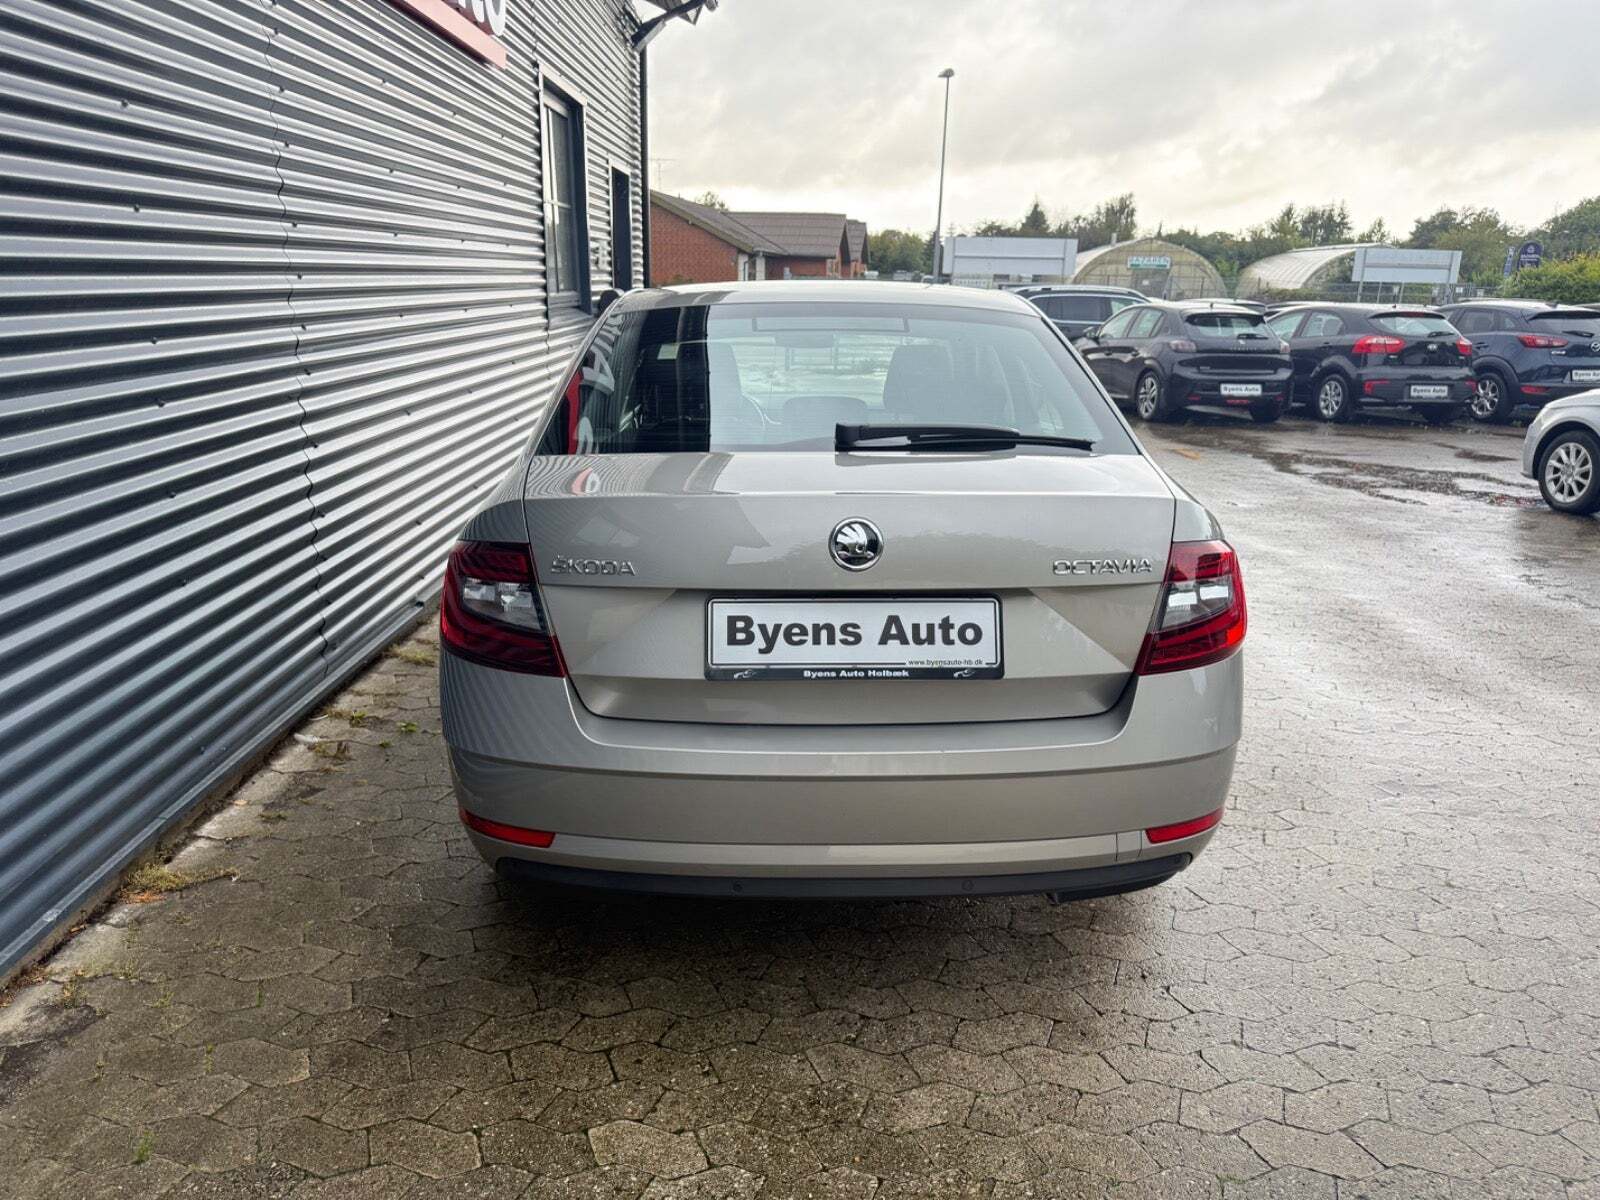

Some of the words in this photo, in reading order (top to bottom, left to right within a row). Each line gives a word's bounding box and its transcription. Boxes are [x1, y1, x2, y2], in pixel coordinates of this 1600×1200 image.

[551, 554, 635, 576] ŠKODA
[1053, 558, 1152, 575] OCTAVIA
[726, 615, 862, 654] Byens
[878, 614, 983, 646] Auto
[803, 670, 837, 678] Byens
[839, 670, 865, 678] Auto
[867, 669, 909, 678] Holbæk
